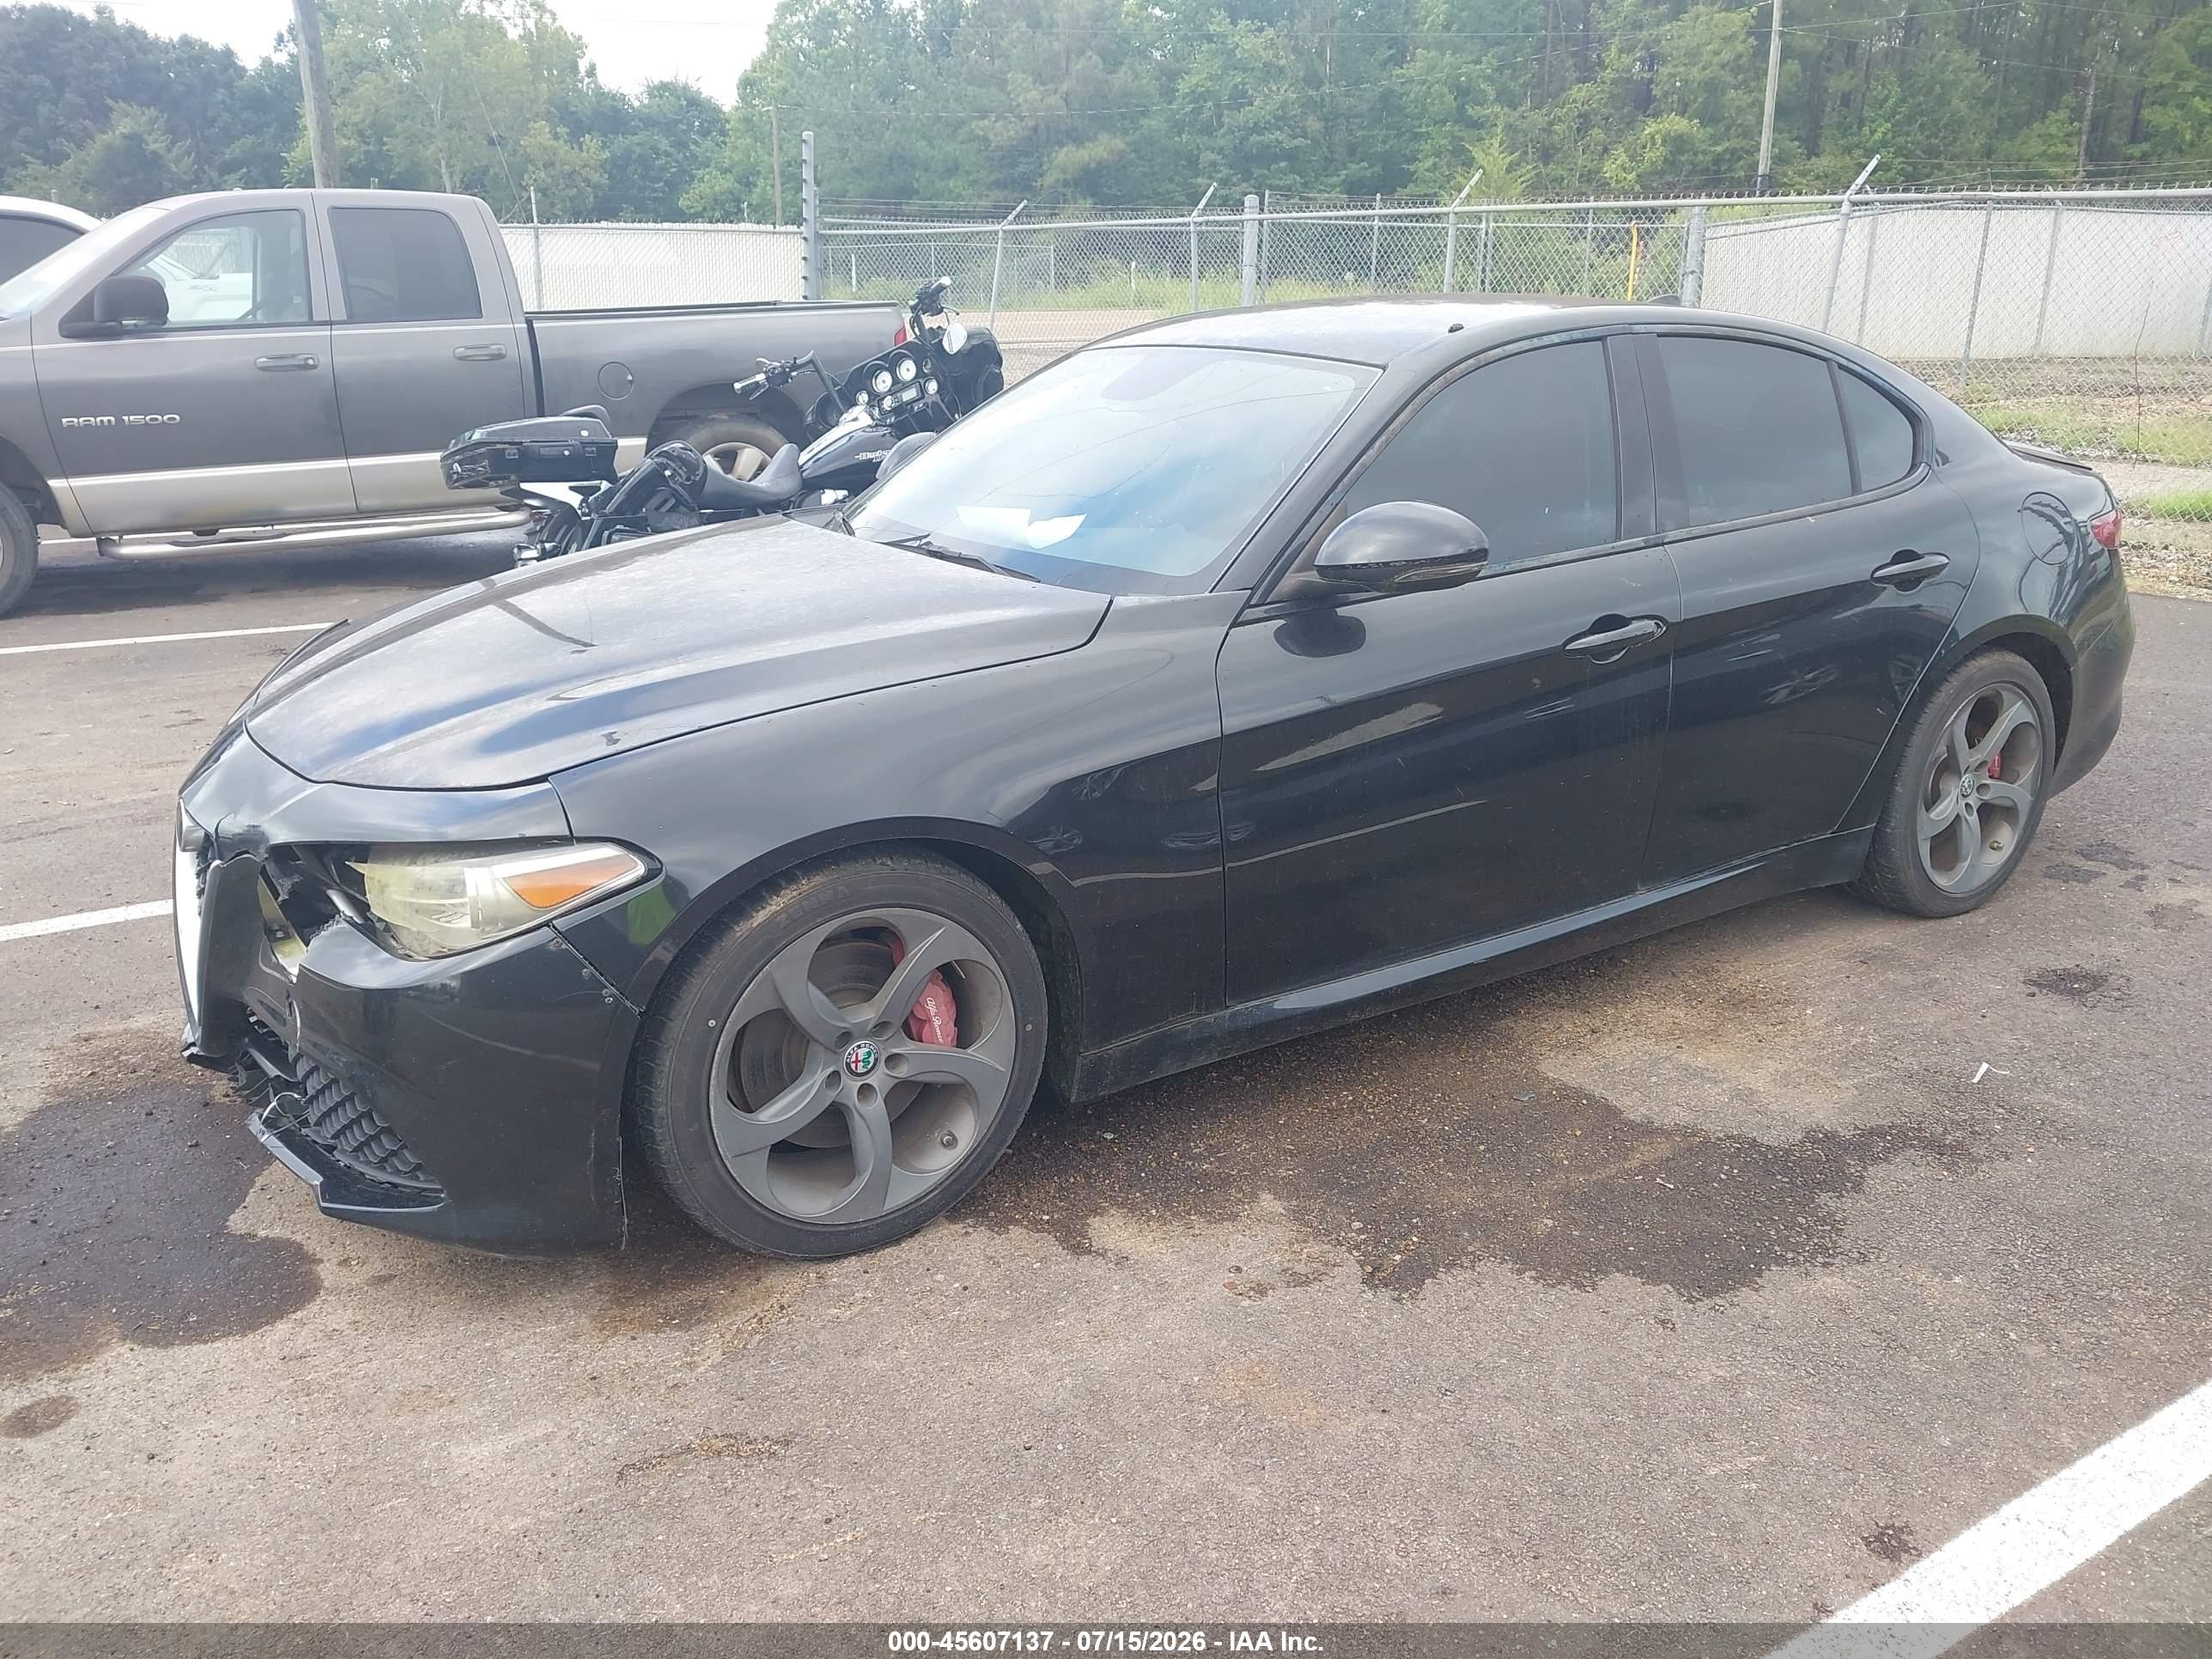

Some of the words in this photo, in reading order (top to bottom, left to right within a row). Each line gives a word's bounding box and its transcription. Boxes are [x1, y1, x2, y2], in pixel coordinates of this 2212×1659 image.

[62, 416, 116, 428] RAM
[122, 414, 180, 425] 1500
[924, 997, 938, 1018] Alfa
